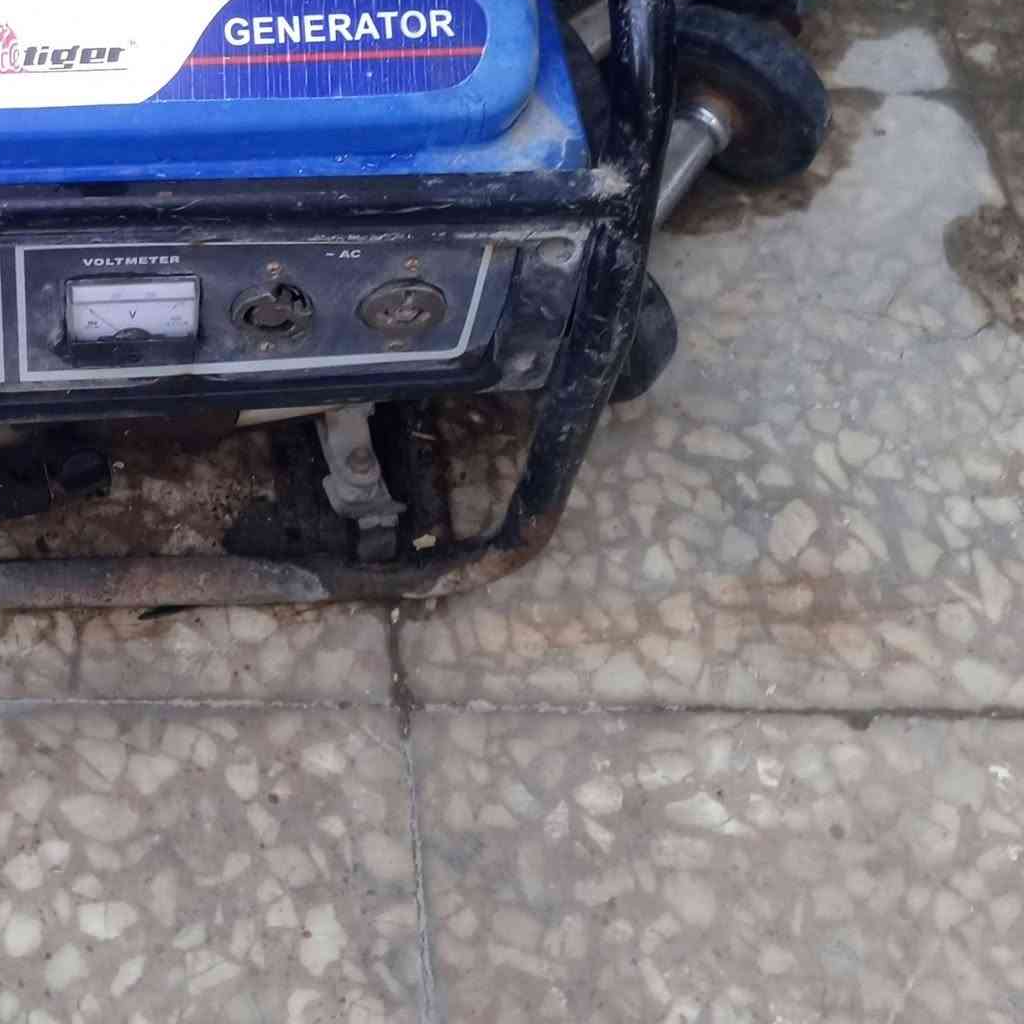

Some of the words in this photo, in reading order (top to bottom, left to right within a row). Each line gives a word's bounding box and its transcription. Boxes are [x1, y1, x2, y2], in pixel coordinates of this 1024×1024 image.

[223, 8, 455, 47] GENERATOR
[23, 45, 126, 70] tiger
[82, 255, 180, 267] VOLTMETER
[338, 249, 362, 259] AC
